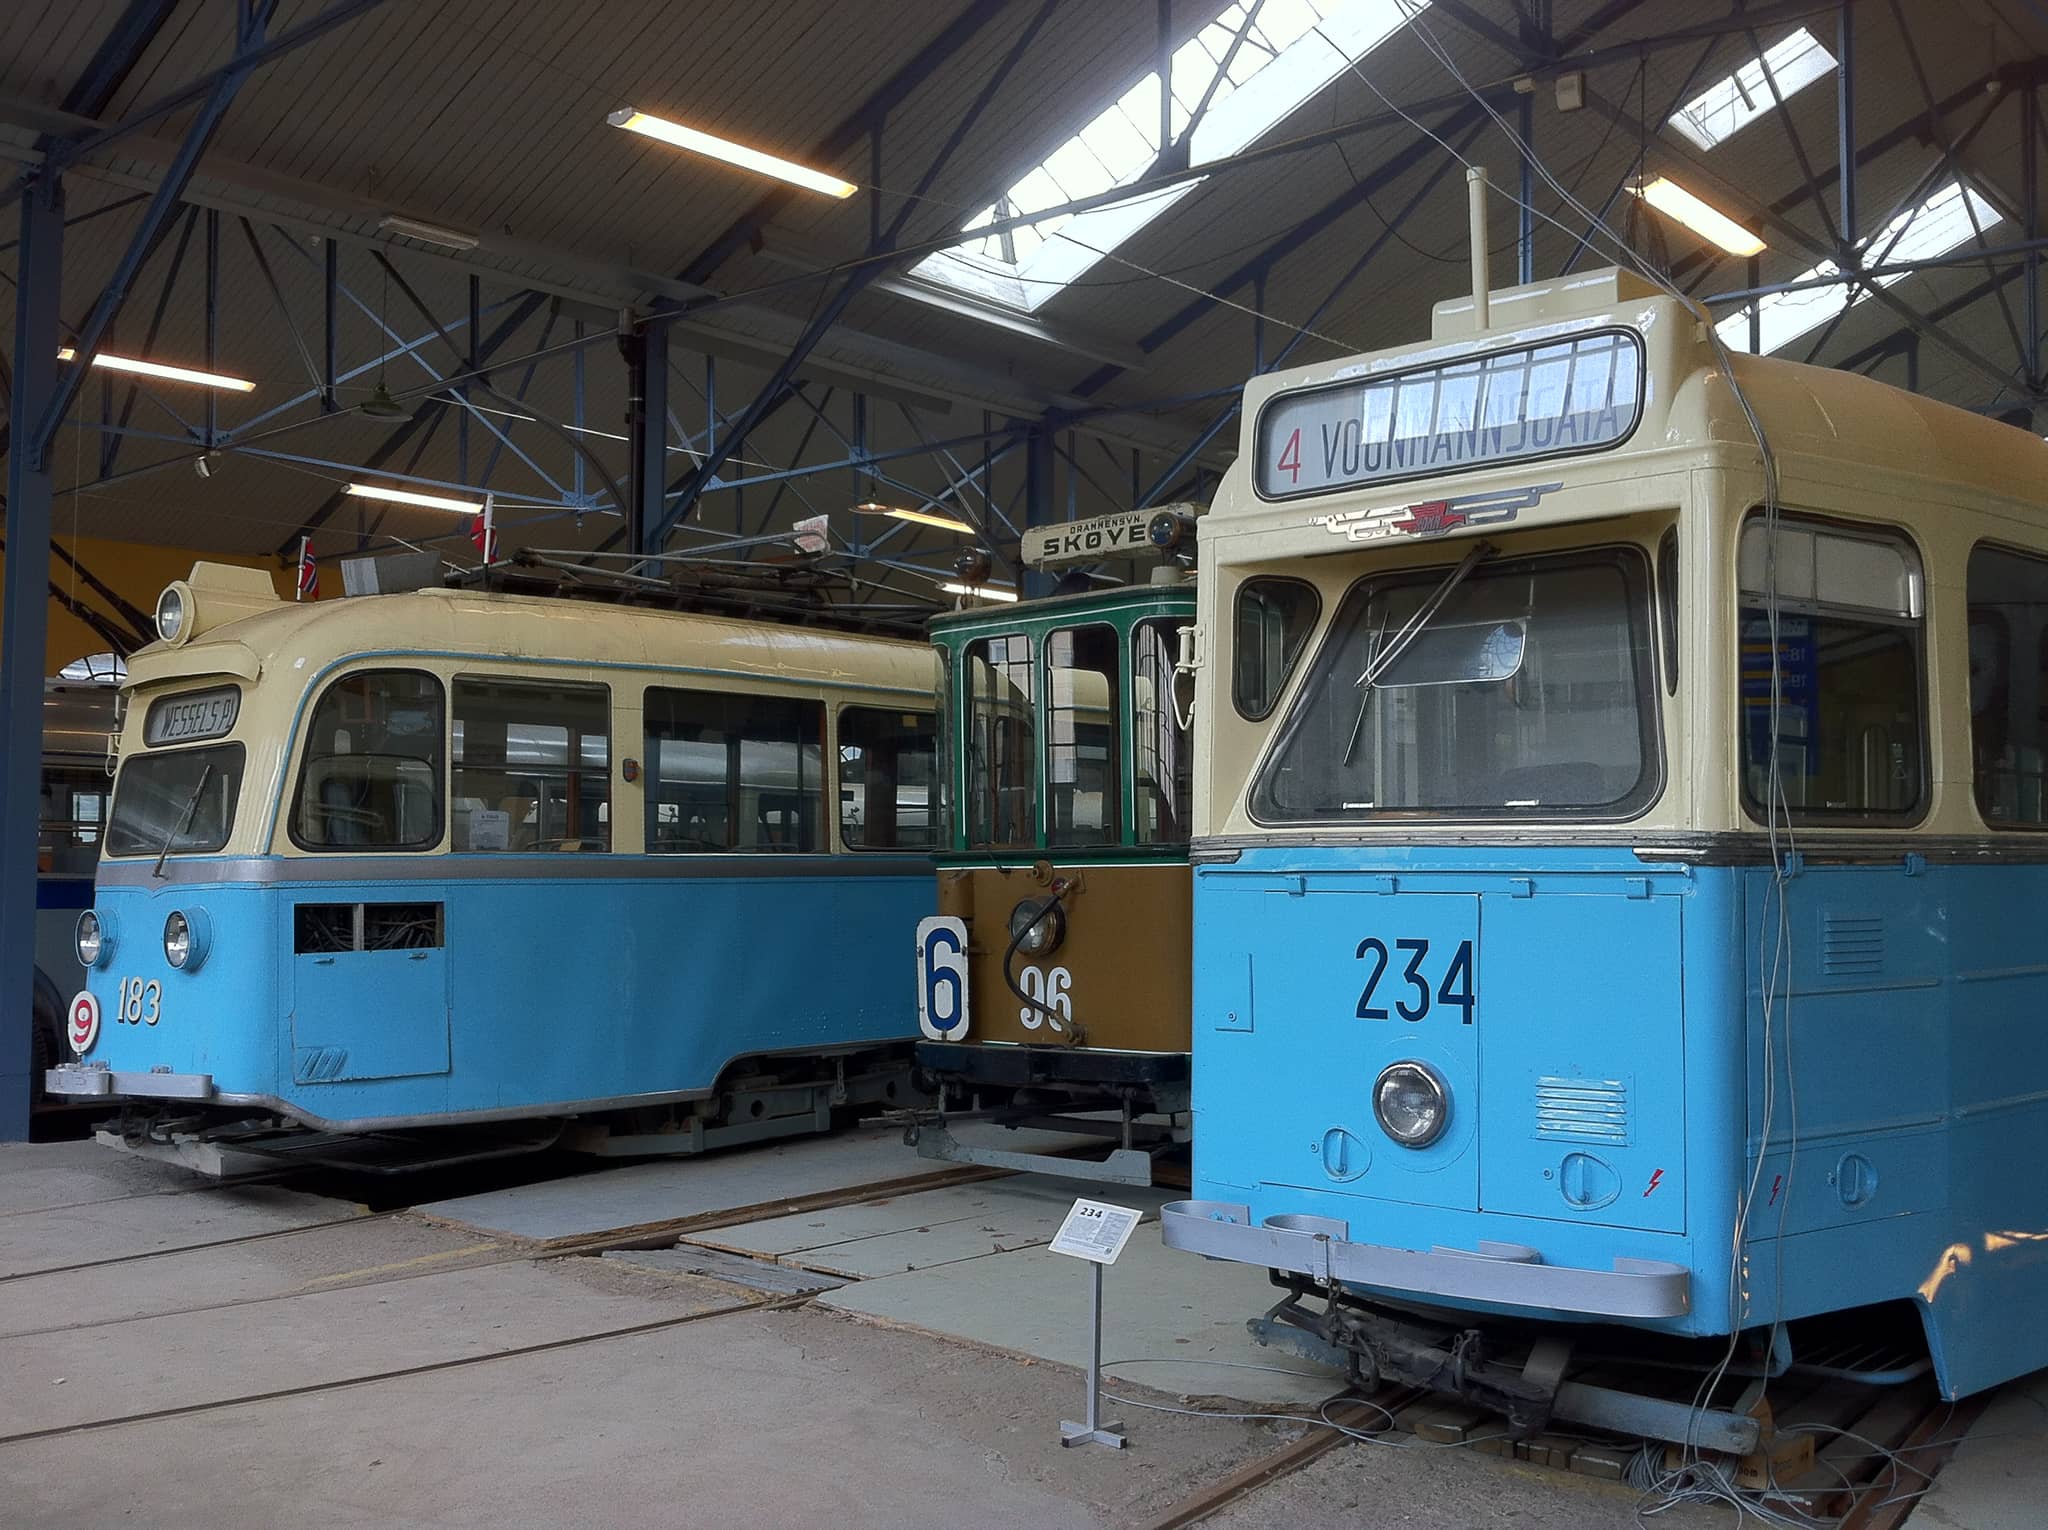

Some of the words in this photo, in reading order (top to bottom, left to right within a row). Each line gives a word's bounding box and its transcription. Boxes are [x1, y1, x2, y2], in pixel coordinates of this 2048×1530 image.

[1277, 428, 1302, 484] 4
[160, 700, 220, 738] WESSELS
[117, 976, 162, 1026] 183
[925, 927, 962, 1032] 6
[1020, 965, 1072, 1032] 96
[1356, 937, 1476, 1026] 234
[73, 999, 93, 1044] 9
[1080, 1207, 1104, 1218] 234
